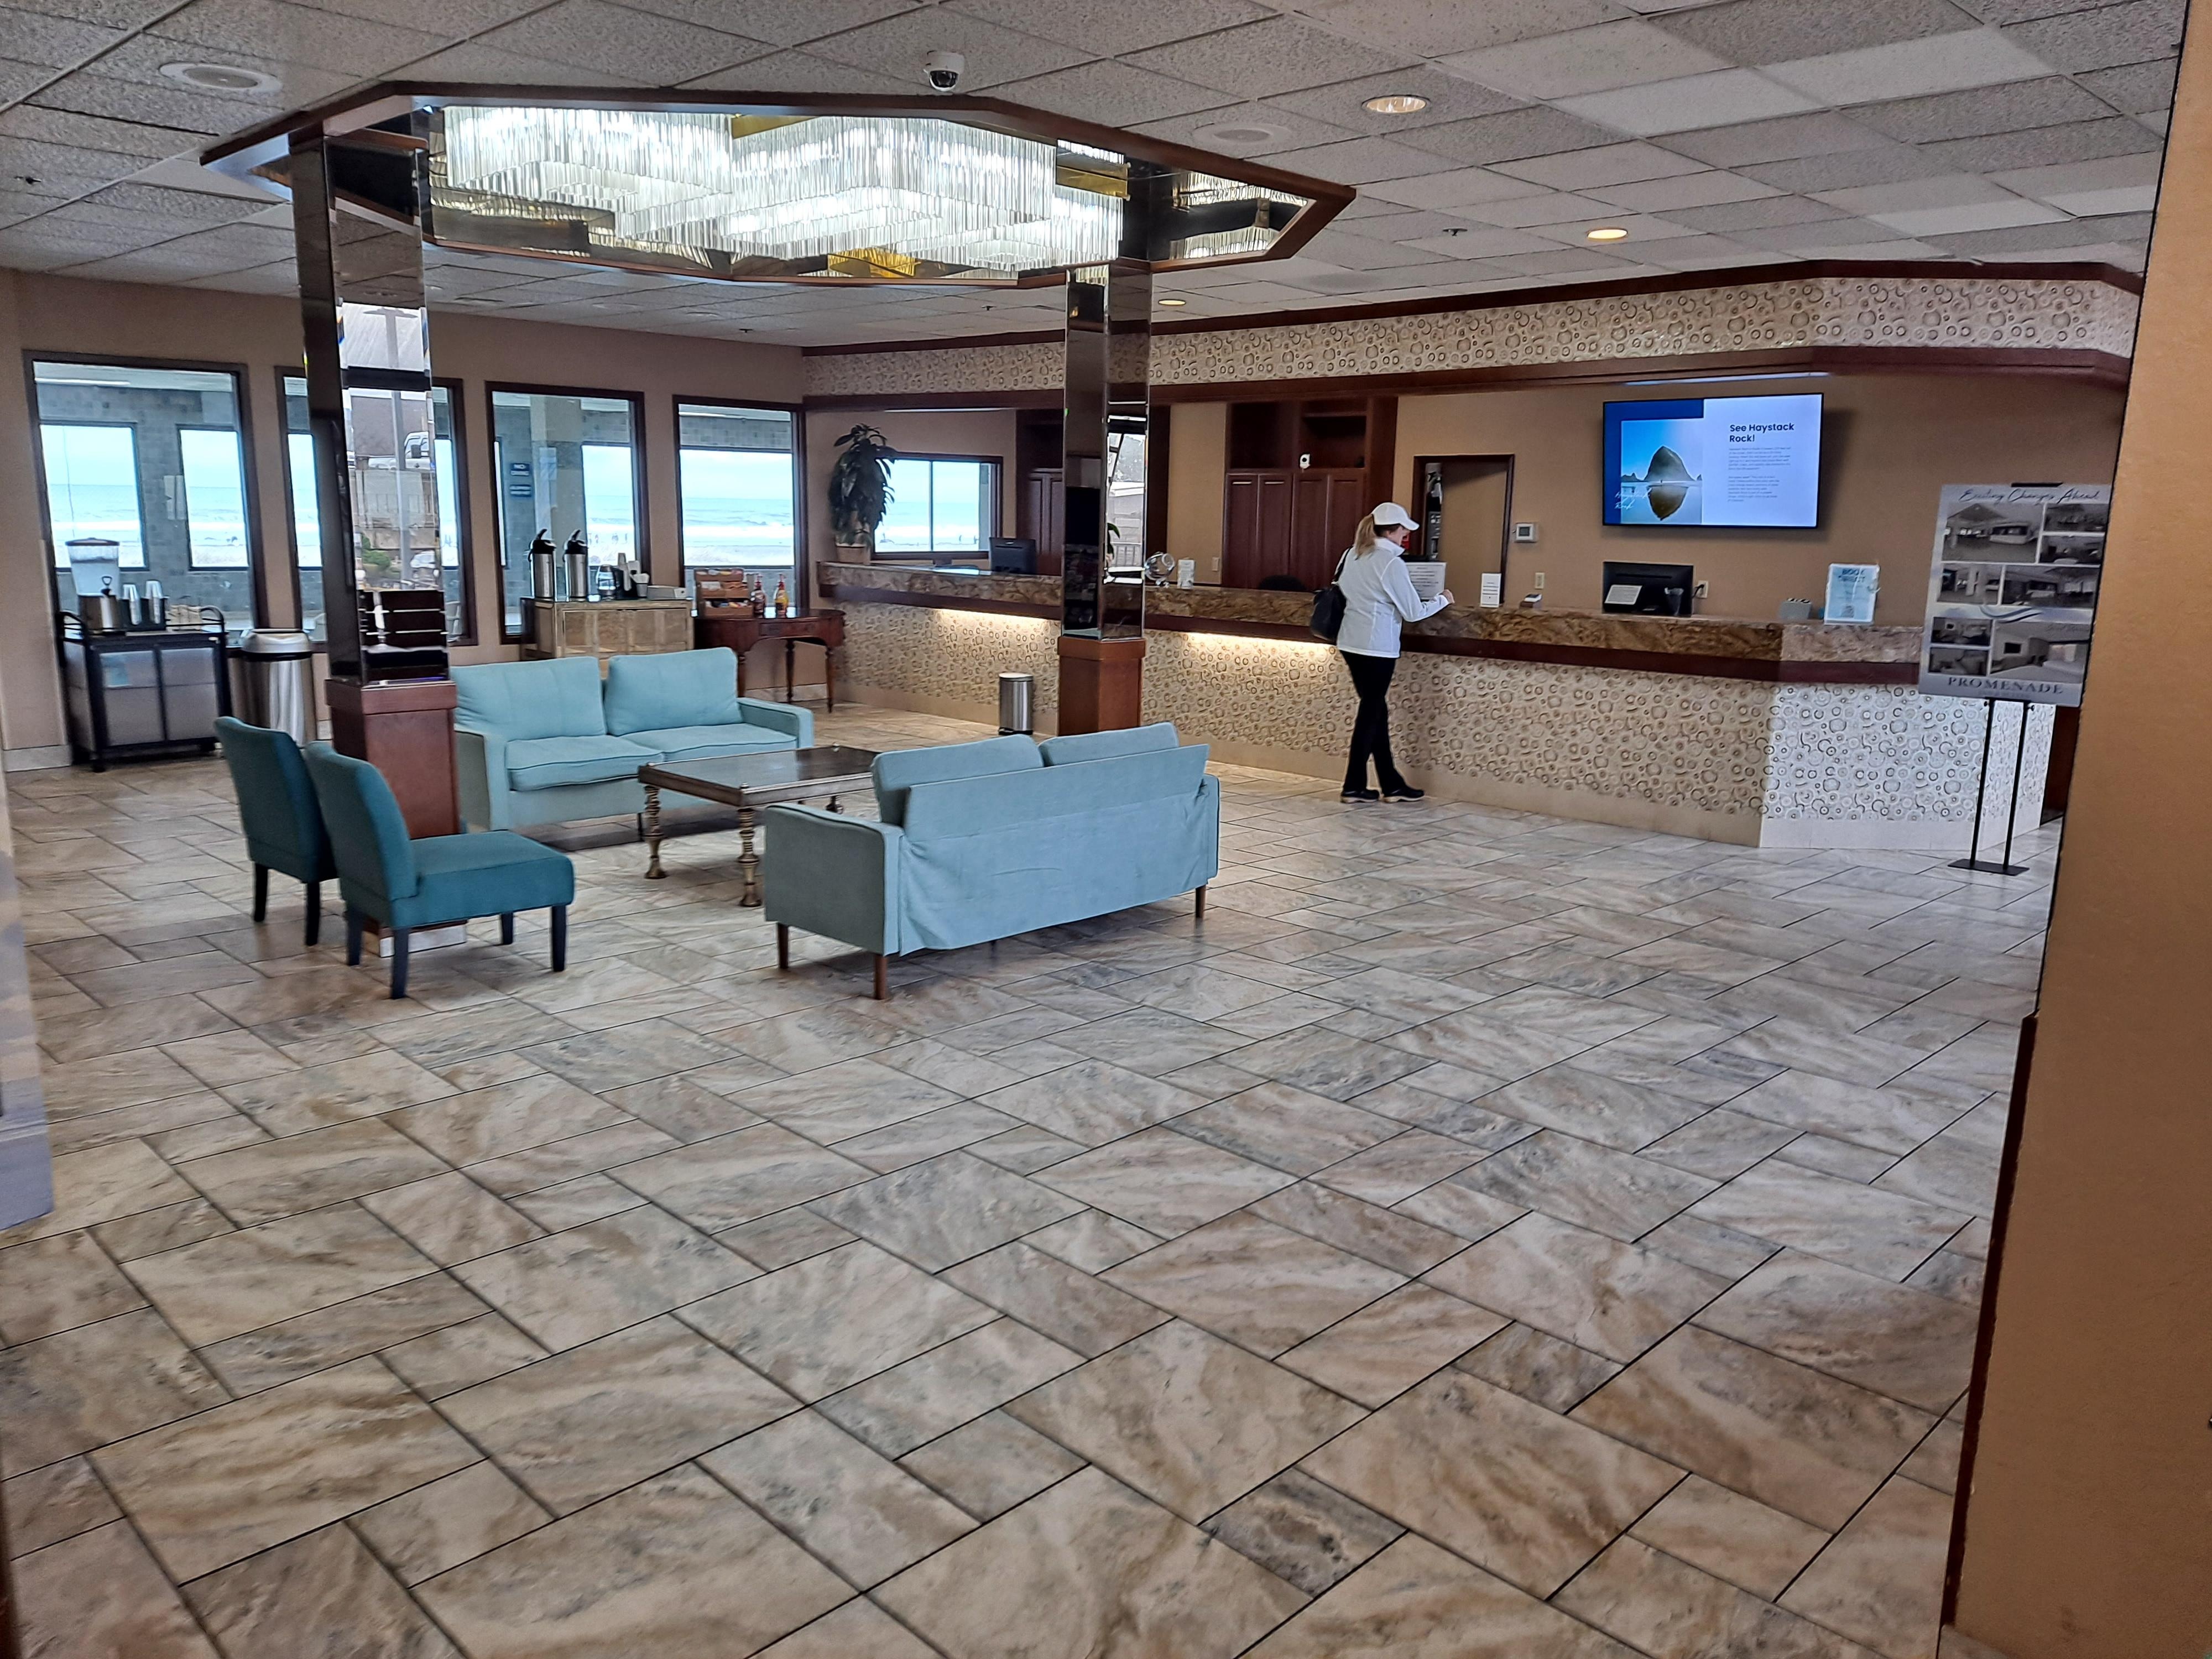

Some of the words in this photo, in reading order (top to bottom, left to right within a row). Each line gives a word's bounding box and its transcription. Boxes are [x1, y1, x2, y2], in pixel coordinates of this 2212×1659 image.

[1749, 422, 1795, 434] Haystack
[1729, 434, 1755, 442] Rock!
[1948, 676, 2064, 695] PROMENADE
